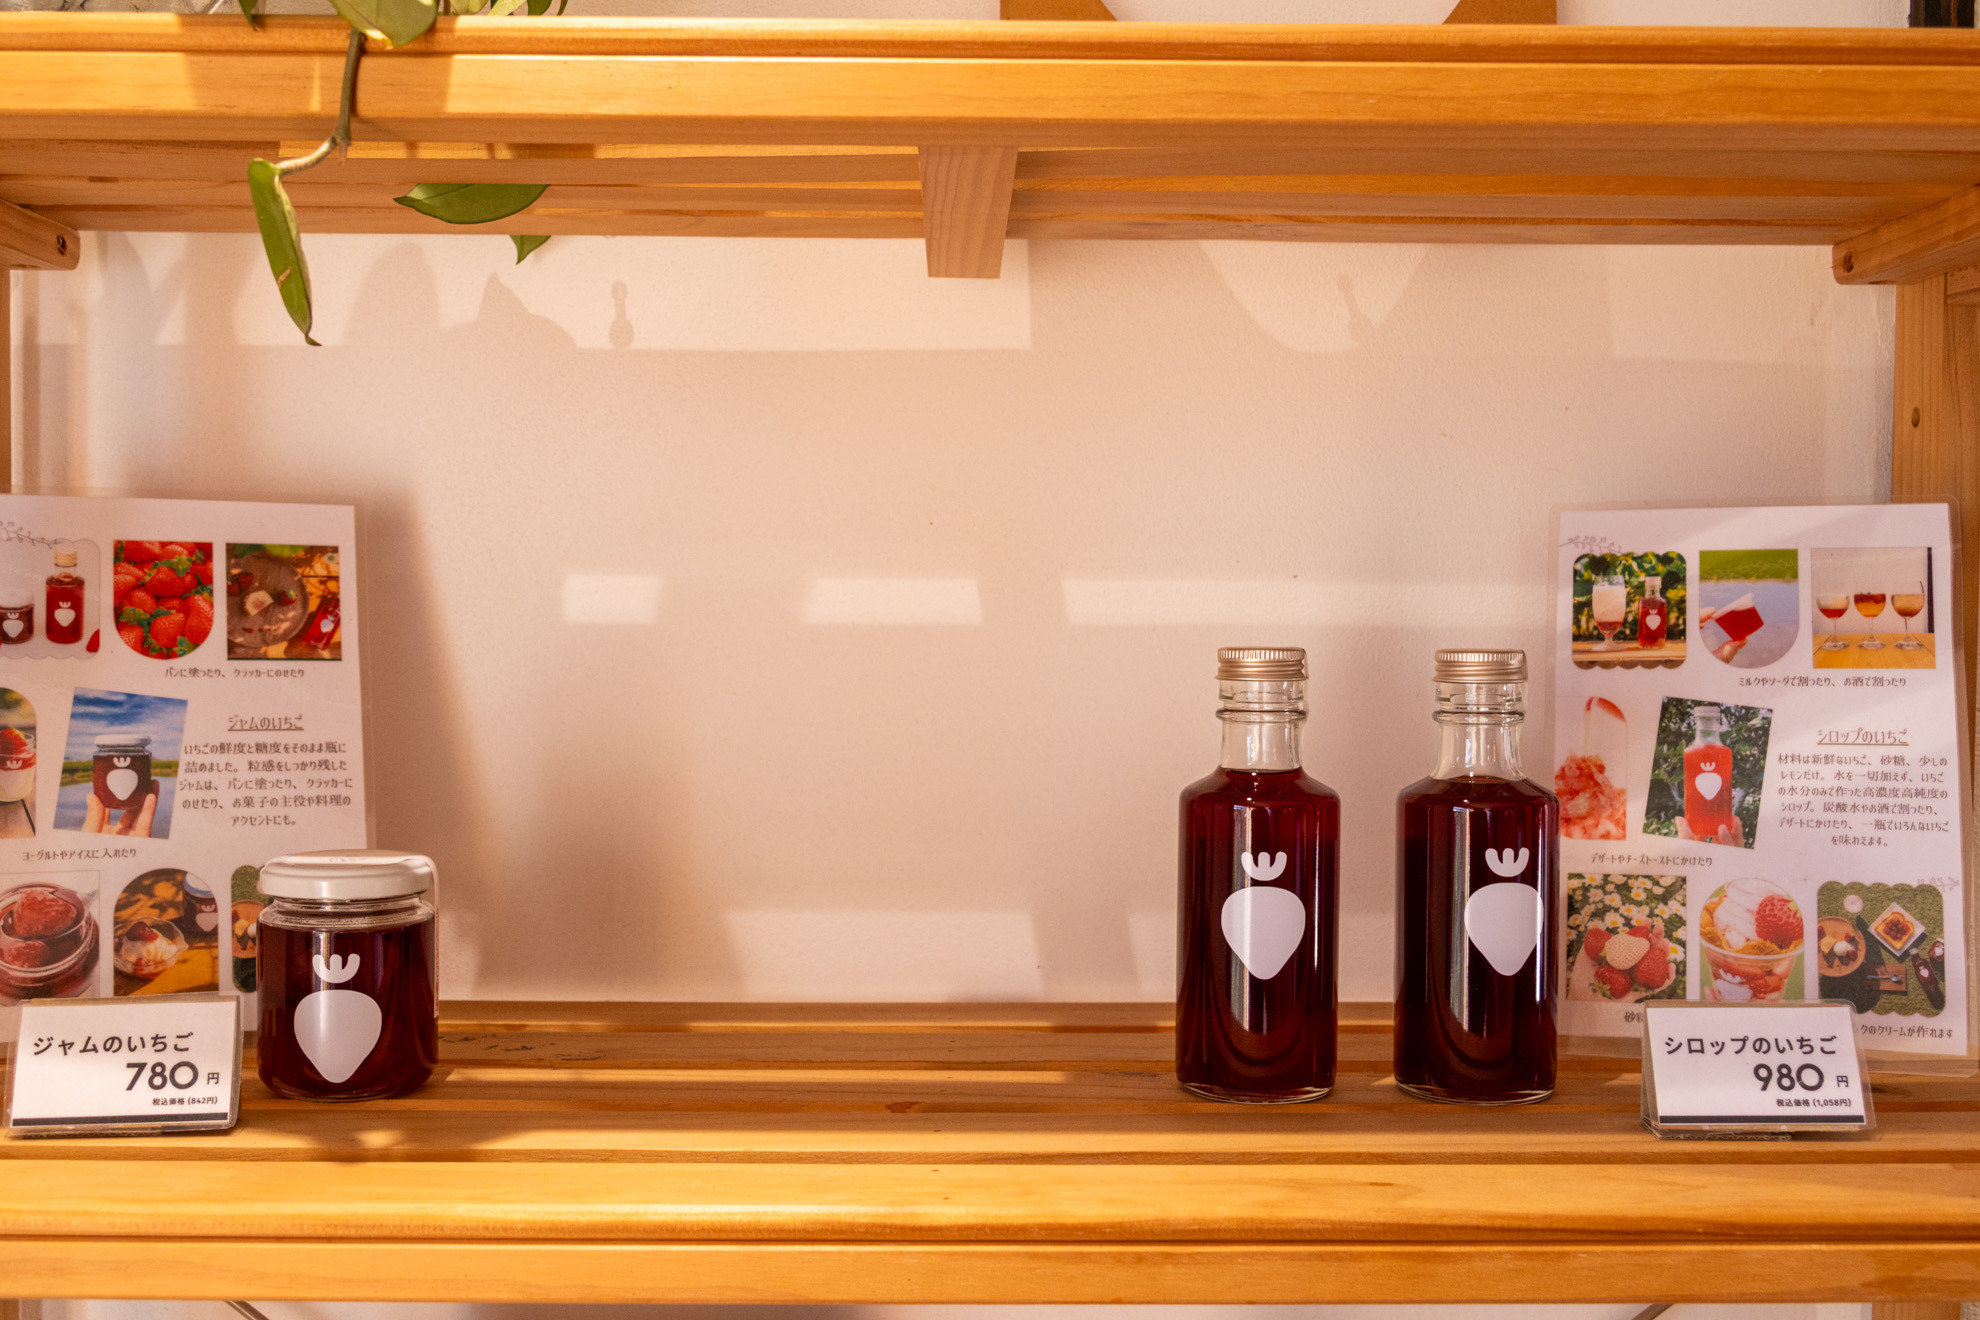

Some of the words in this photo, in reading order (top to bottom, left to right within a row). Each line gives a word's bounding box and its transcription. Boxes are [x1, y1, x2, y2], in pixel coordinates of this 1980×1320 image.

[227, 714, 304, 731] ジャムのいちご
[1817, 728, 1908, 744] シロップのいちご
[33, 1032, 194, 1056] ジャムのいちご
[1664, 1035, 1838, 1056] シロップのいちご
[126, 1061, 199, 1091] 780
[206, 1072, 220, 1085] 円
[1753, 1062, 1825, 1092] 980
[1836, 1075, 1849, 1088] 円
